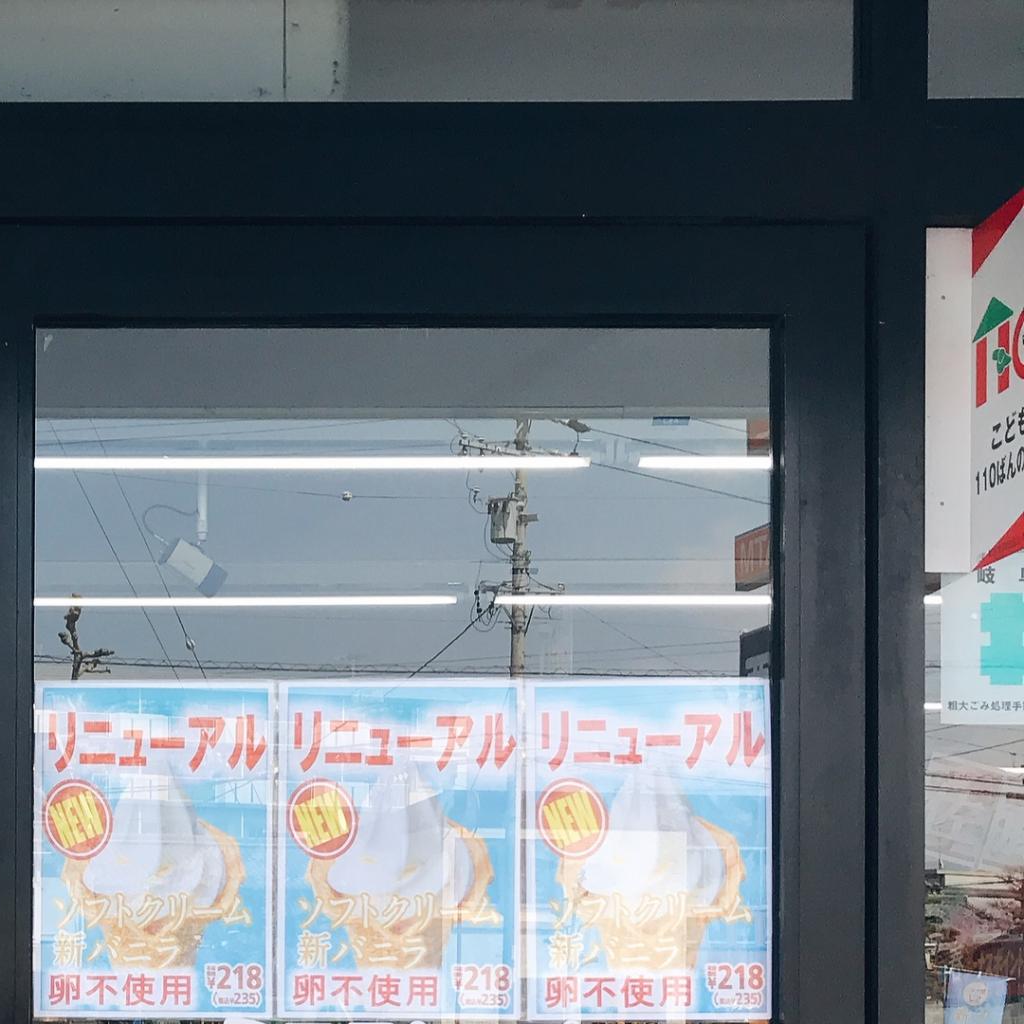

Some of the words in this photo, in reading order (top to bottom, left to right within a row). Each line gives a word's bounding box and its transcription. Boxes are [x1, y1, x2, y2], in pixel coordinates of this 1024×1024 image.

[947, 700, 1024, 712] 粗大ごみ処理手
[48, 712, 267, 773] リニューアル
[294, 711, 517, 772] リニューアル
[541, 711, 765, 769] リニューアル
[49, 791, 104, 849] NEW
[294, 790, 349, 849] NEW
[543, 790, 600, 849] NEW
[56, 893, 253, 929] ソフトクリーム
[53, 930, 182, 969] 新バニラ
[48, 975, 192, 1007] 卵不使用
[293, 974, 439, 1008] 卵不使用
[545, 975, 693, 1008] 卵不使用
